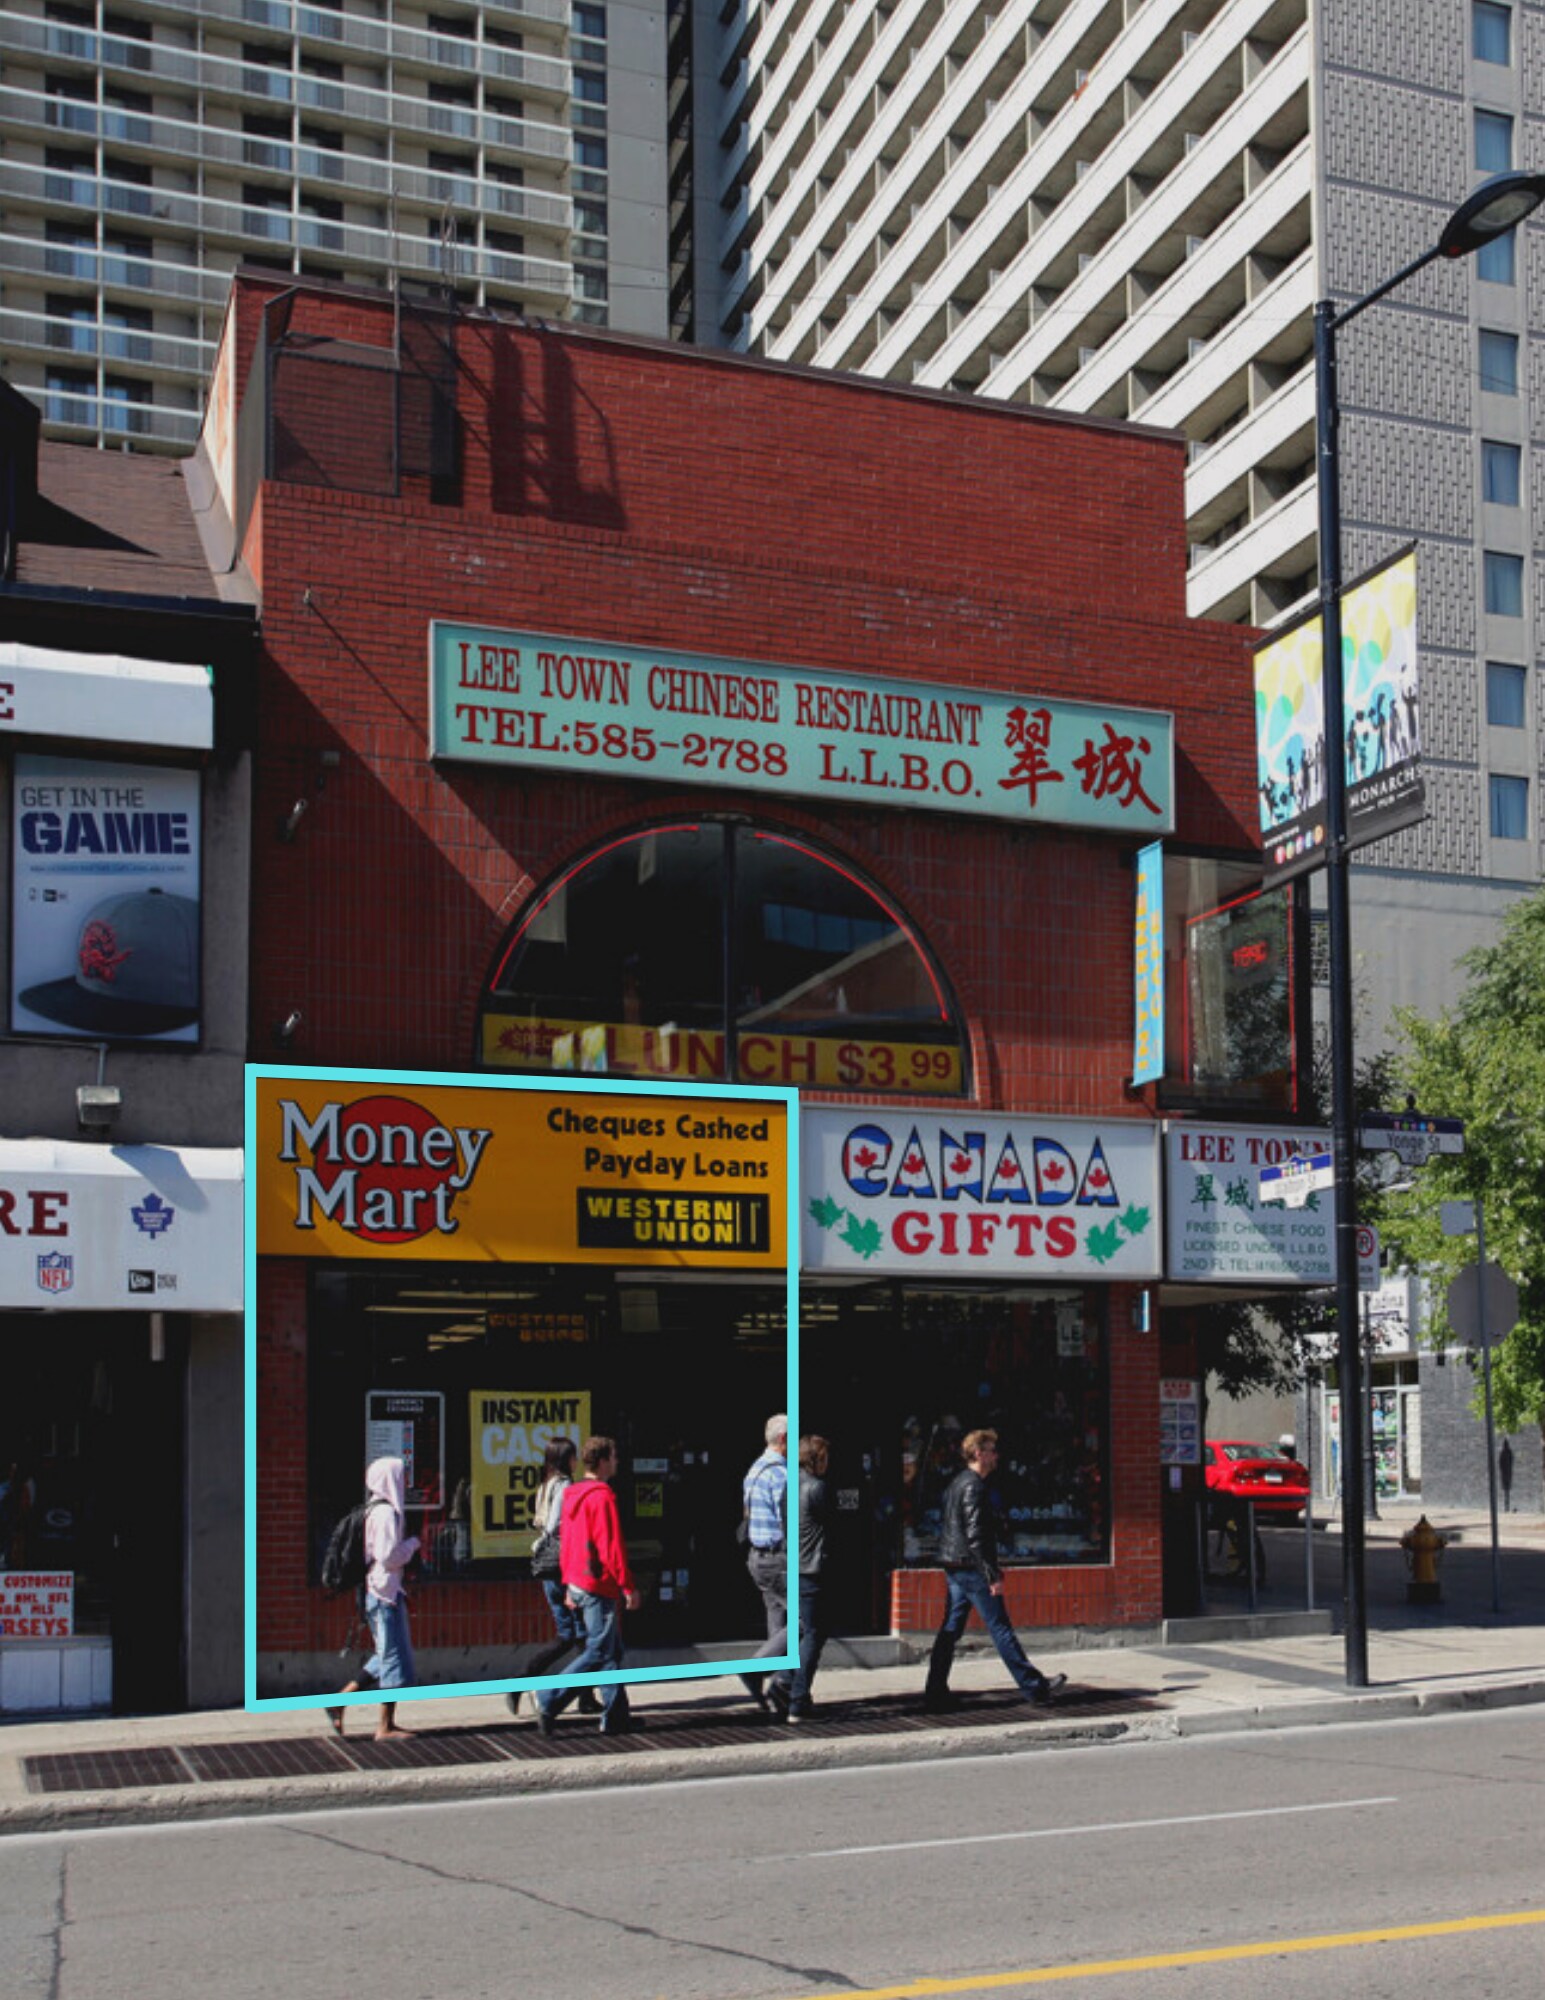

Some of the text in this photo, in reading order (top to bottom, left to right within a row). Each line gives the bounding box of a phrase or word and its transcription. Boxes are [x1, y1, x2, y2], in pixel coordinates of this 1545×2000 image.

[458, 642, 982, 746] LEE TOWN CHINESE RESTAURANT
[455, 703, 982, 797] TEL:585-2788 L.L.B.O.
[997, 705, 1163, 816] 翠城
[21, 786, 144, 808] GET IN THE
[20, 812, 191, 854] GAME
[608, 1026, 816, 1083] LUNCH
[836, 1041, 952, 1088] $3.99
[547, 1107, 769, 1142] Cheques Cashed
[278, 1100, 493, 1187] Money
[1180, 1133, 1236, 1164] LEE
[1387, 1132, 1425, 1153] Yonge
[584, 1148, 769, 1181] Payday Loans
[842, 1124, 1120, 1207] CANADA
[295, 1166, 460, 1233] Mart
[586, 1197, 735, 1221] WESTERN
[634, 1220, 735, 1244] UNION
[891, 1210, 1078, 1258] GIFTS
[1185, 1220, 1326, 1238] FINEST CHINESE FOOD
[1182, 1240, 1240, 1254] LICENSED
[1245, 1241, 1285, 1255] UNDER
[40, 1267, 71, 1288] NFL
[1182, 1259, 1208, 1271] 2ND
[482, 1399, 580, 1423] INSTANT
[508, 1465, 545, 1490] FO
